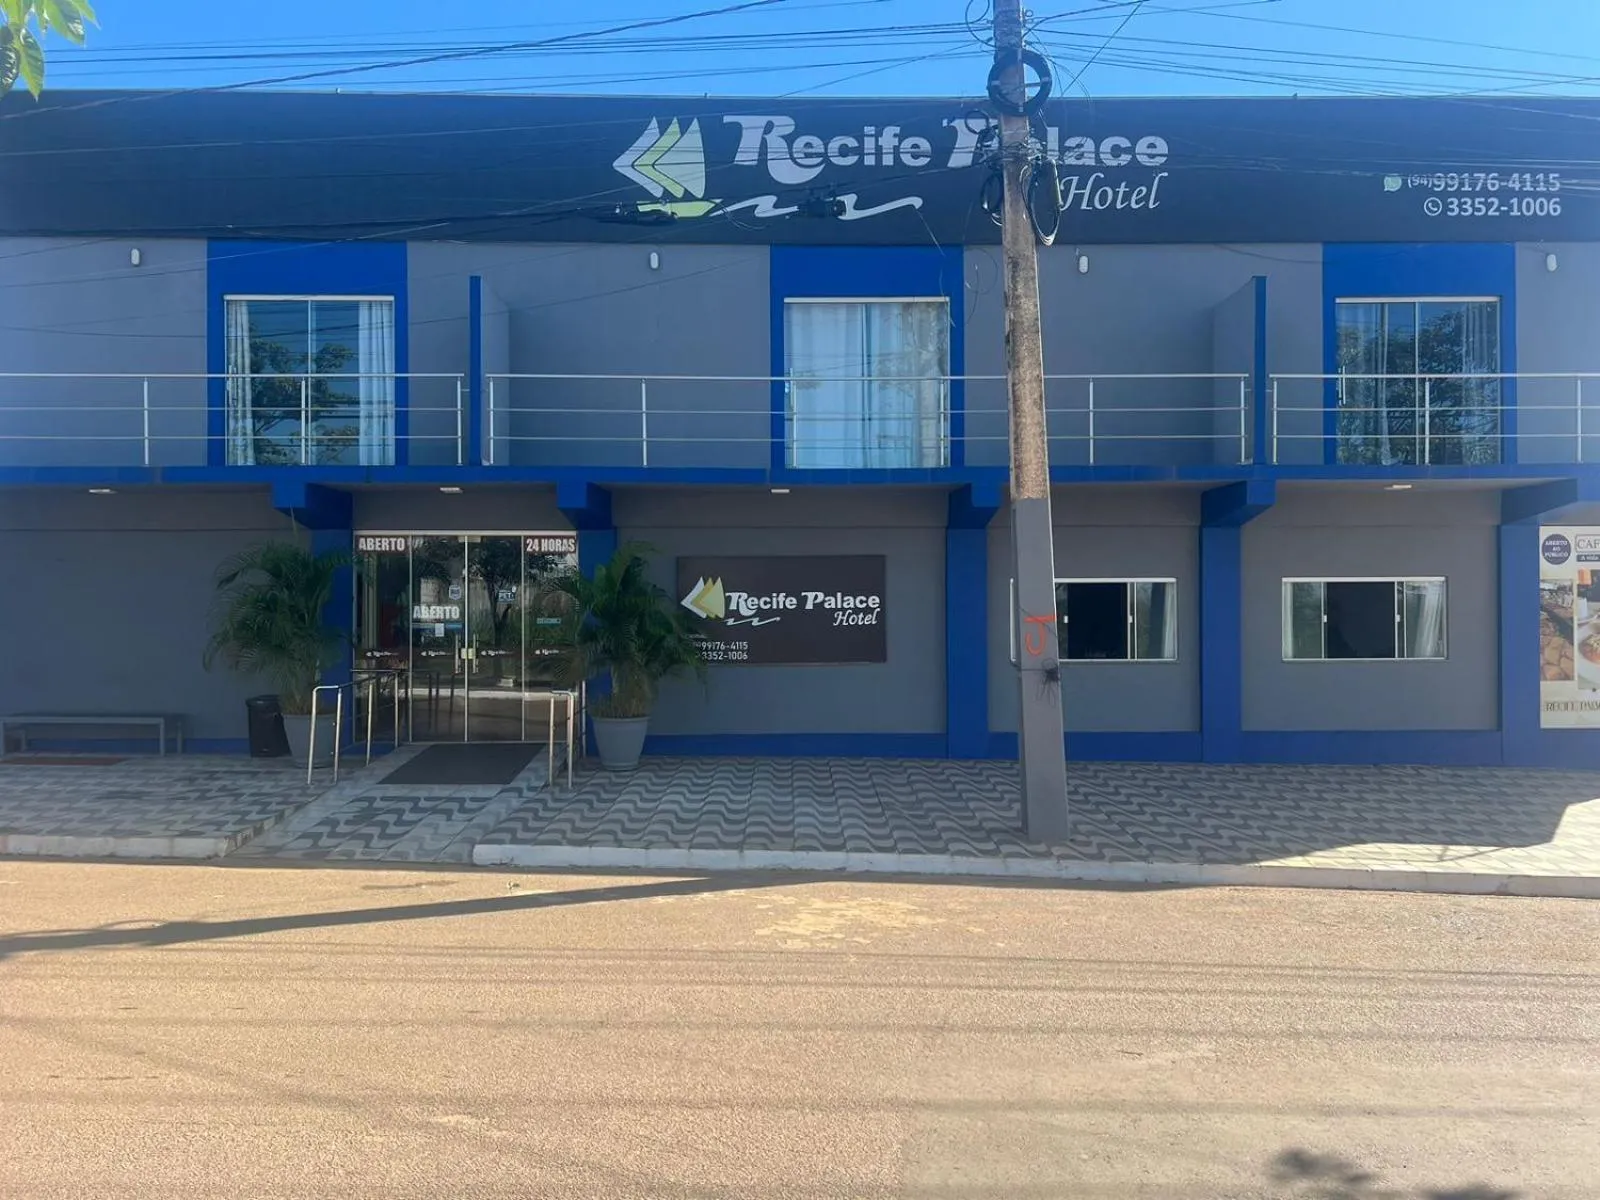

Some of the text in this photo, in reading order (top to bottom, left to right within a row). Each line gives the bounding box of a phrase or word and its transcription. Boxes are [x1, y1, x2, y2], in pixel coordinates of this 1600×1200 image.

[723, 115, 1169, 184] Recife Place
[1060, 172, 1169, 211] Hotel
[1447, 197, 1562, 216] 3352-1006
[358, 537, 405, 551] ABERTO
[526, 538, 576, 552] 24 HORAS
[413, 605, 460, 619] ABERTO
[726, 592, 880, 616] Recife Palace
[832, 608, 881, 626] Hotel
[701, 651, 749, 660] 3352-1006
